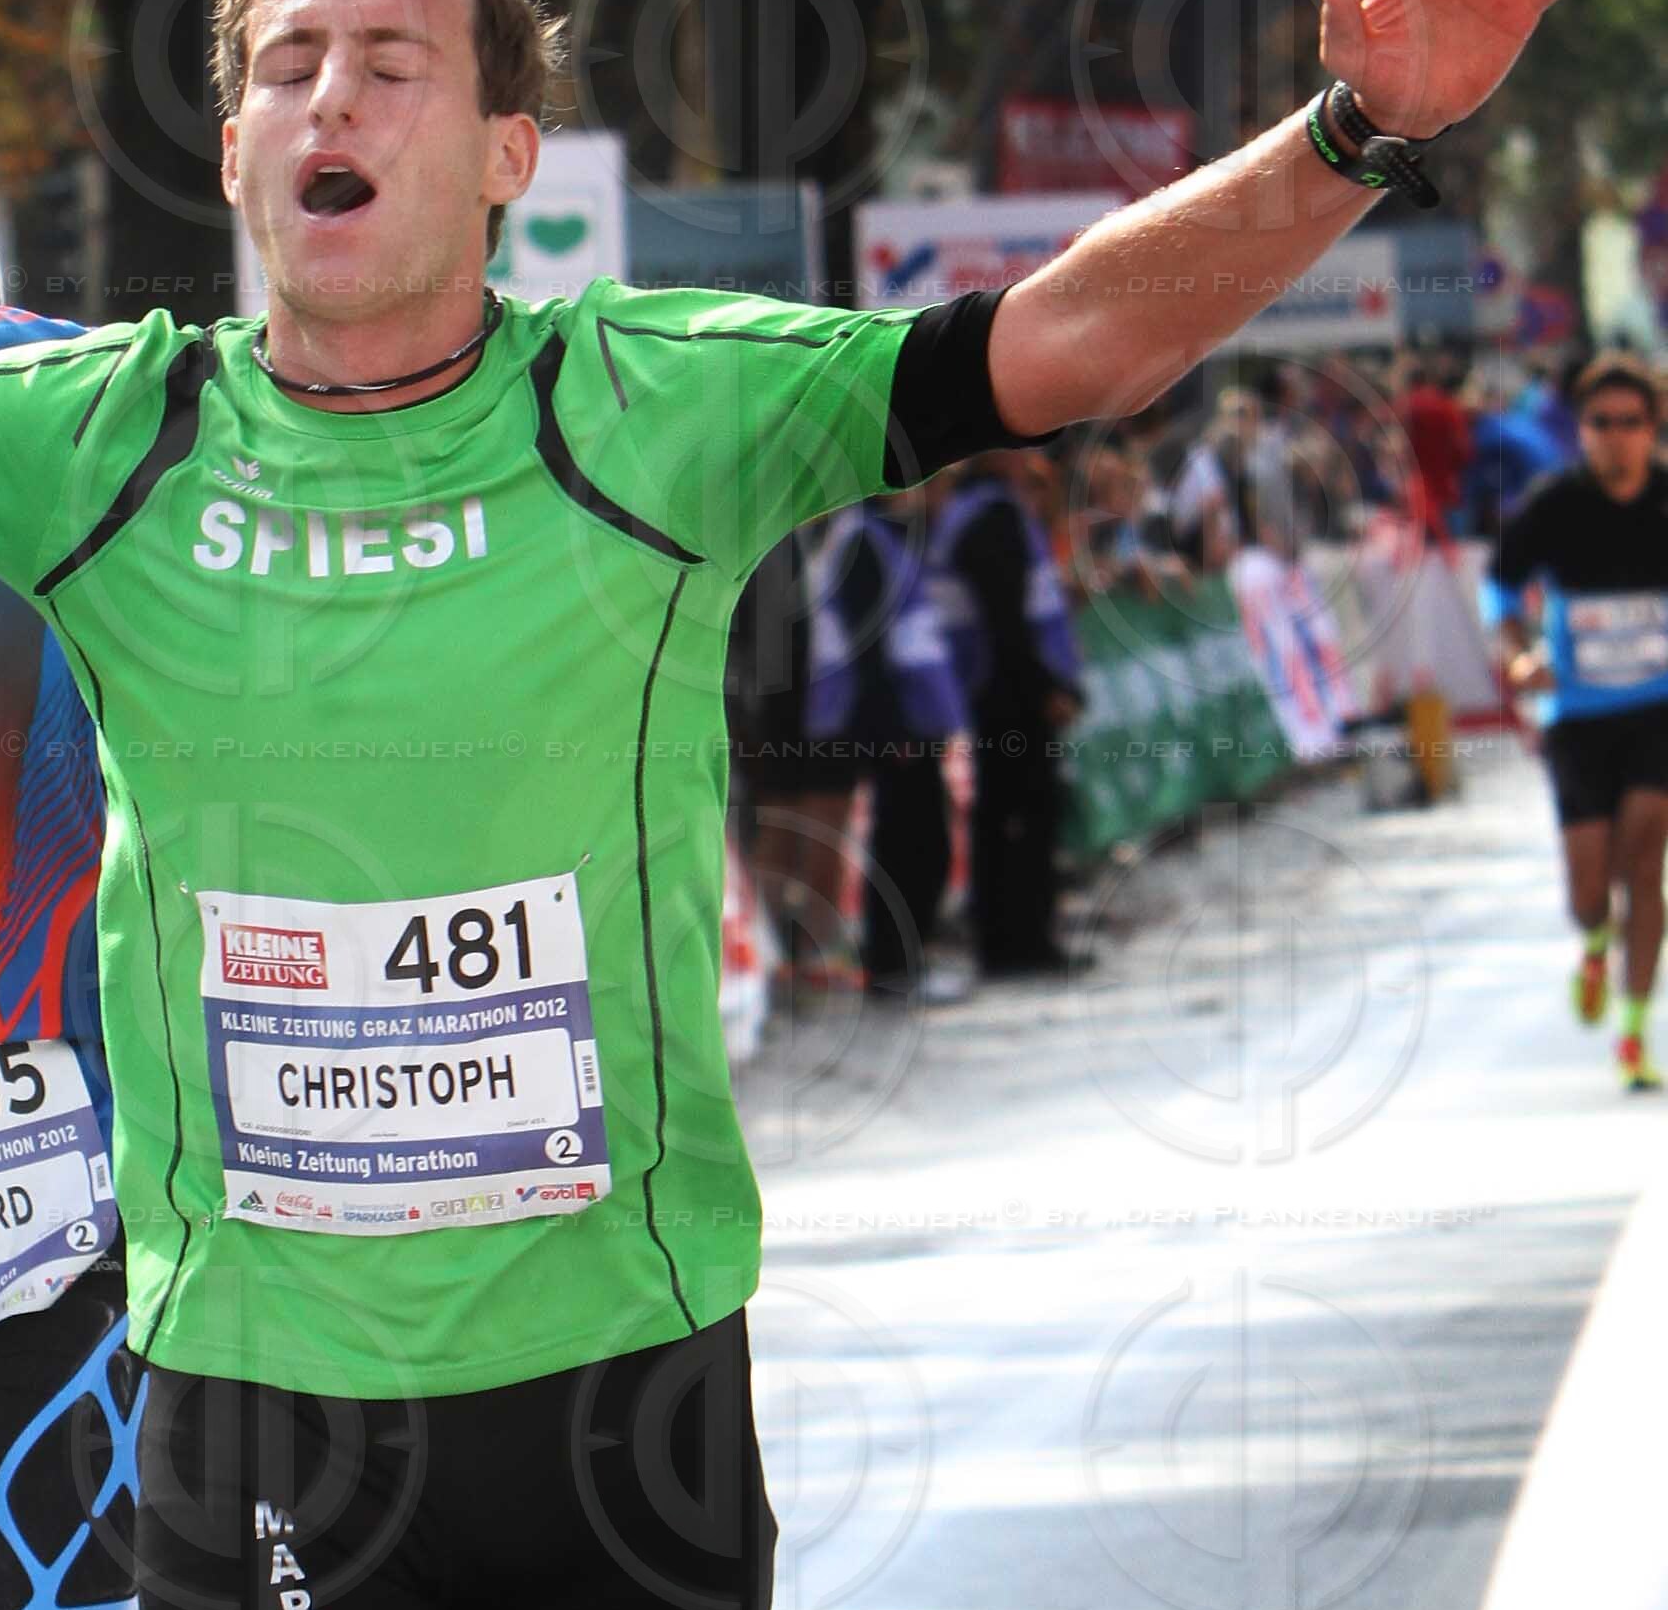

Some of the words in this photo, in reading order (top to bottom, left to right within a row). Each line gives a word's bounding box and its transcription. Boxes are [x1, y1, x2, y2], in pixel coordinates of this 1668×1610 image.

[193, 496, 489, 578] SPIESI
[226, 930, 321, 961] KLEINE
[384, 900, 532, 994] 481
[226, 959, 325, 987] ZEITUNG
[221, 1011, 279, 1035] KLEINE
[283, 1018, 357, 1039] ZEITUNG
[362, 1019, 412, 1038] GRAZ
[418, 1004, 517, 1035] MARATHON
[522, 997, 568, 1022] 2012
[277, 1054, 517, 1110] CHRISTOPH
[38, 1124, 79, 1152] 2012
[555, 1135, 580, 1158] 2
[237, 1142, 293, 1169] Kleine
[297, 1150, 372, 1178] Zeitung
[377, 1150, 479, 1173] Marathon
[431, 1193, 504, 1217] GRAZ
[73, 1224, 95, 1248] 2
